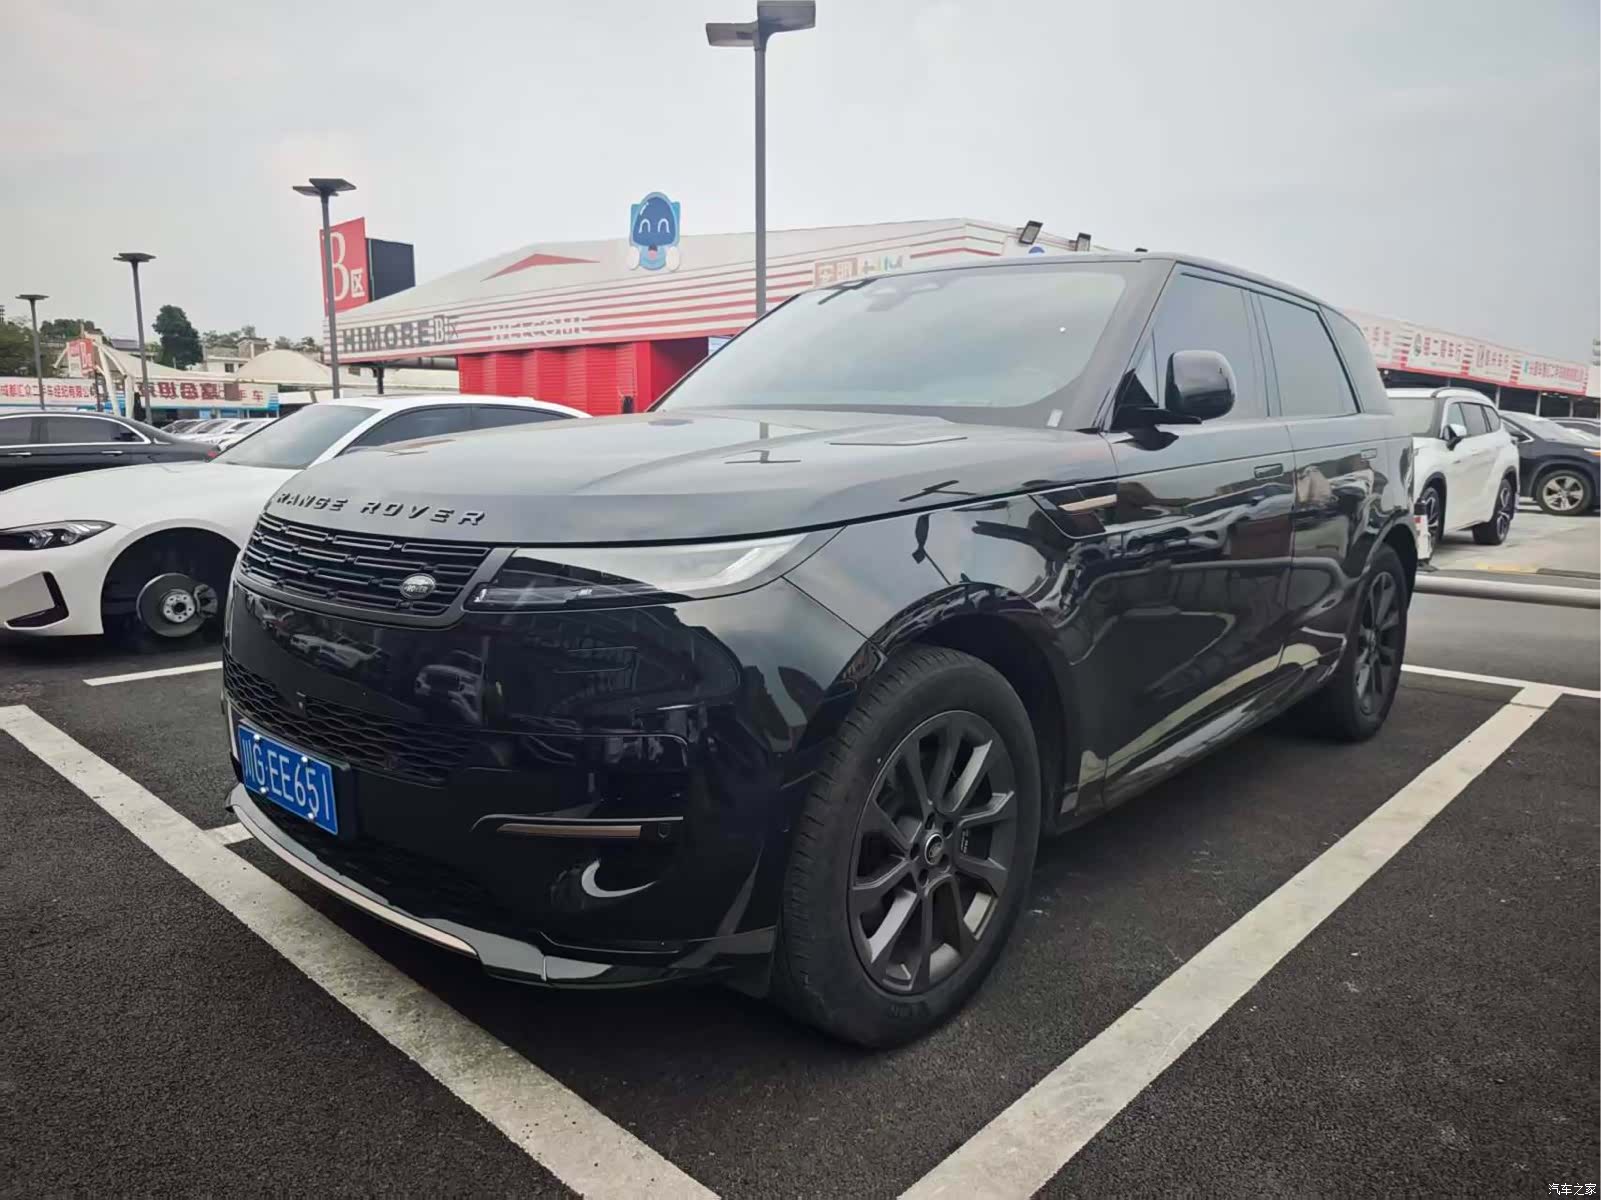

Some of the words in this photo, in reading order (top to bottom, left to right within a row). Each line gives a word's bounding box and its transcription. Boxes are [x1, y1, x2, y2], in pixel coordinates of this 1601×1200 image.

[343, 319, 431, 354] HIMORE
[489, 313, 592, 341] WELCOME
[276, 492, 348, 512] RANGE
[360, 501, 486, 526] ROVER
